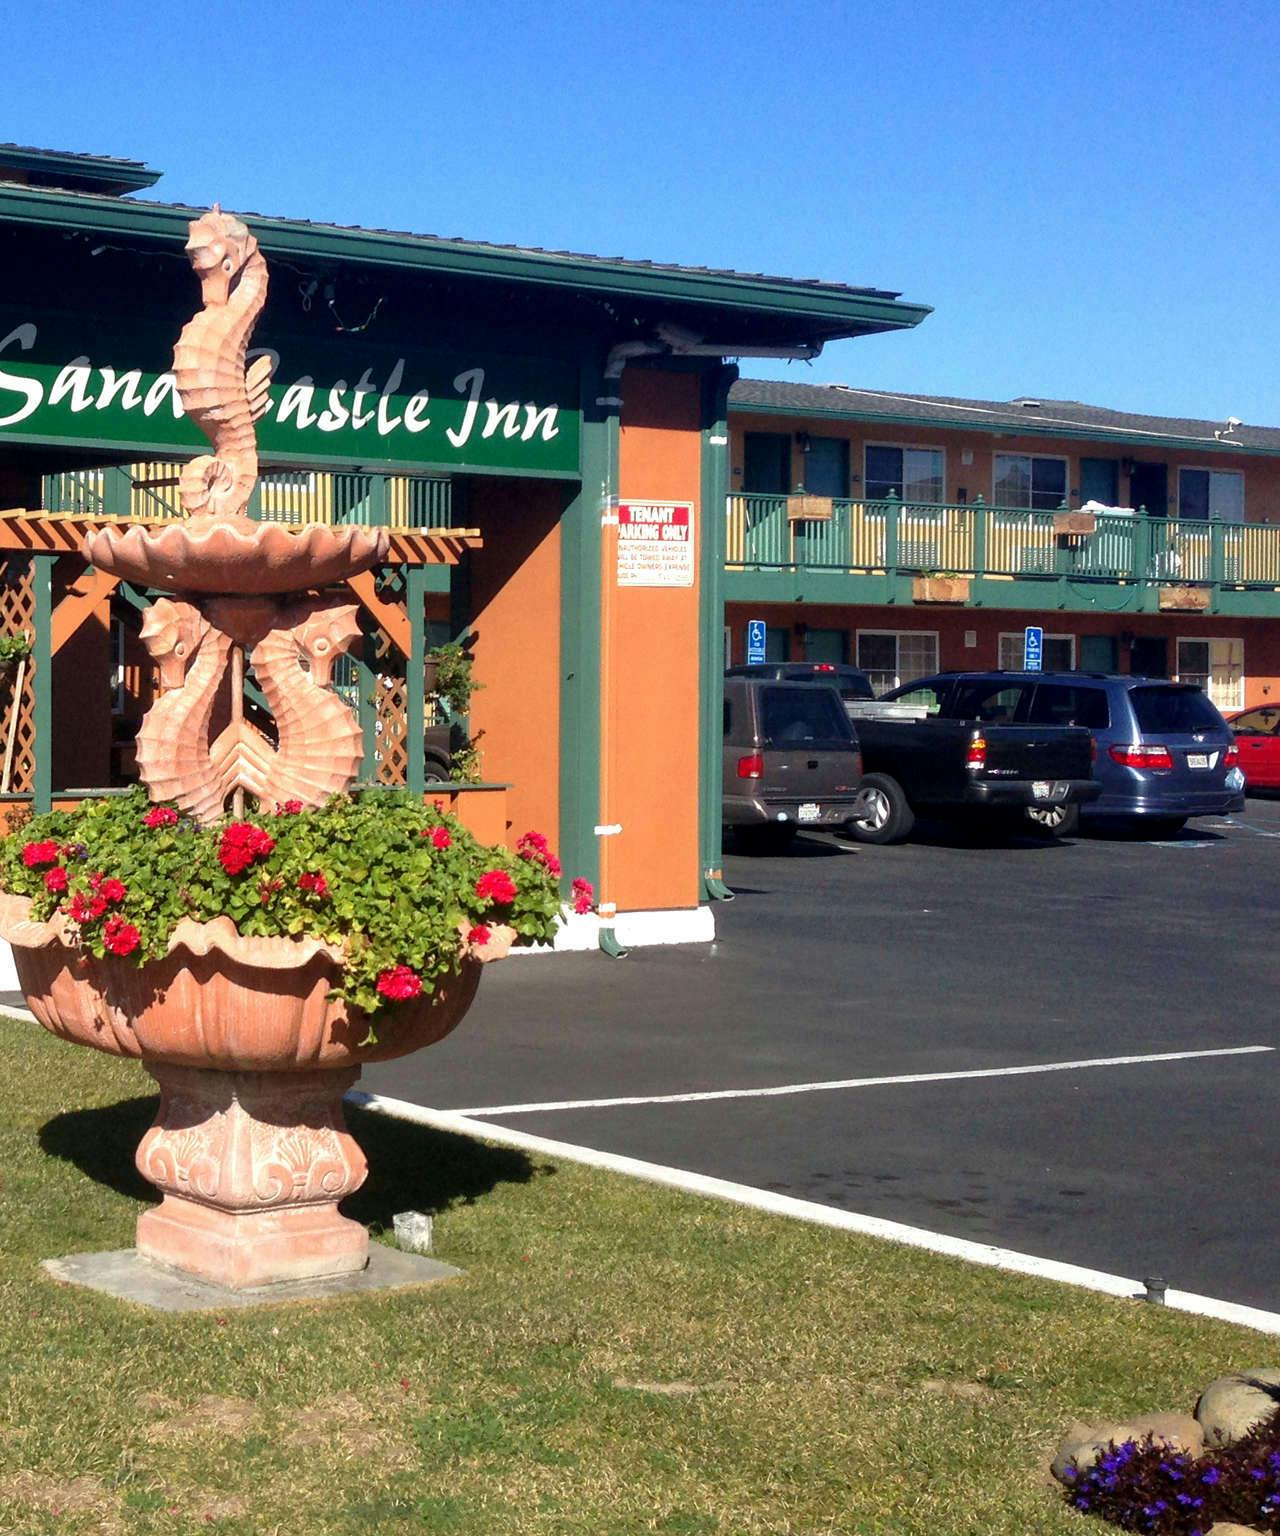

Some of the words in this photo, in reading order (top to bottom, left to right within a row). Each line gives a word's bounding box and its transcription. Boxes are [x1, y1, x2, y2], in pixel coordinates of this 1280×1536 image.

[446, 367, 559, 448] Inn
[628, 506, 675, 523] TENANT
[619, 523, 659, 540] ARKING
[662, 525, 688, 540] ONLY
